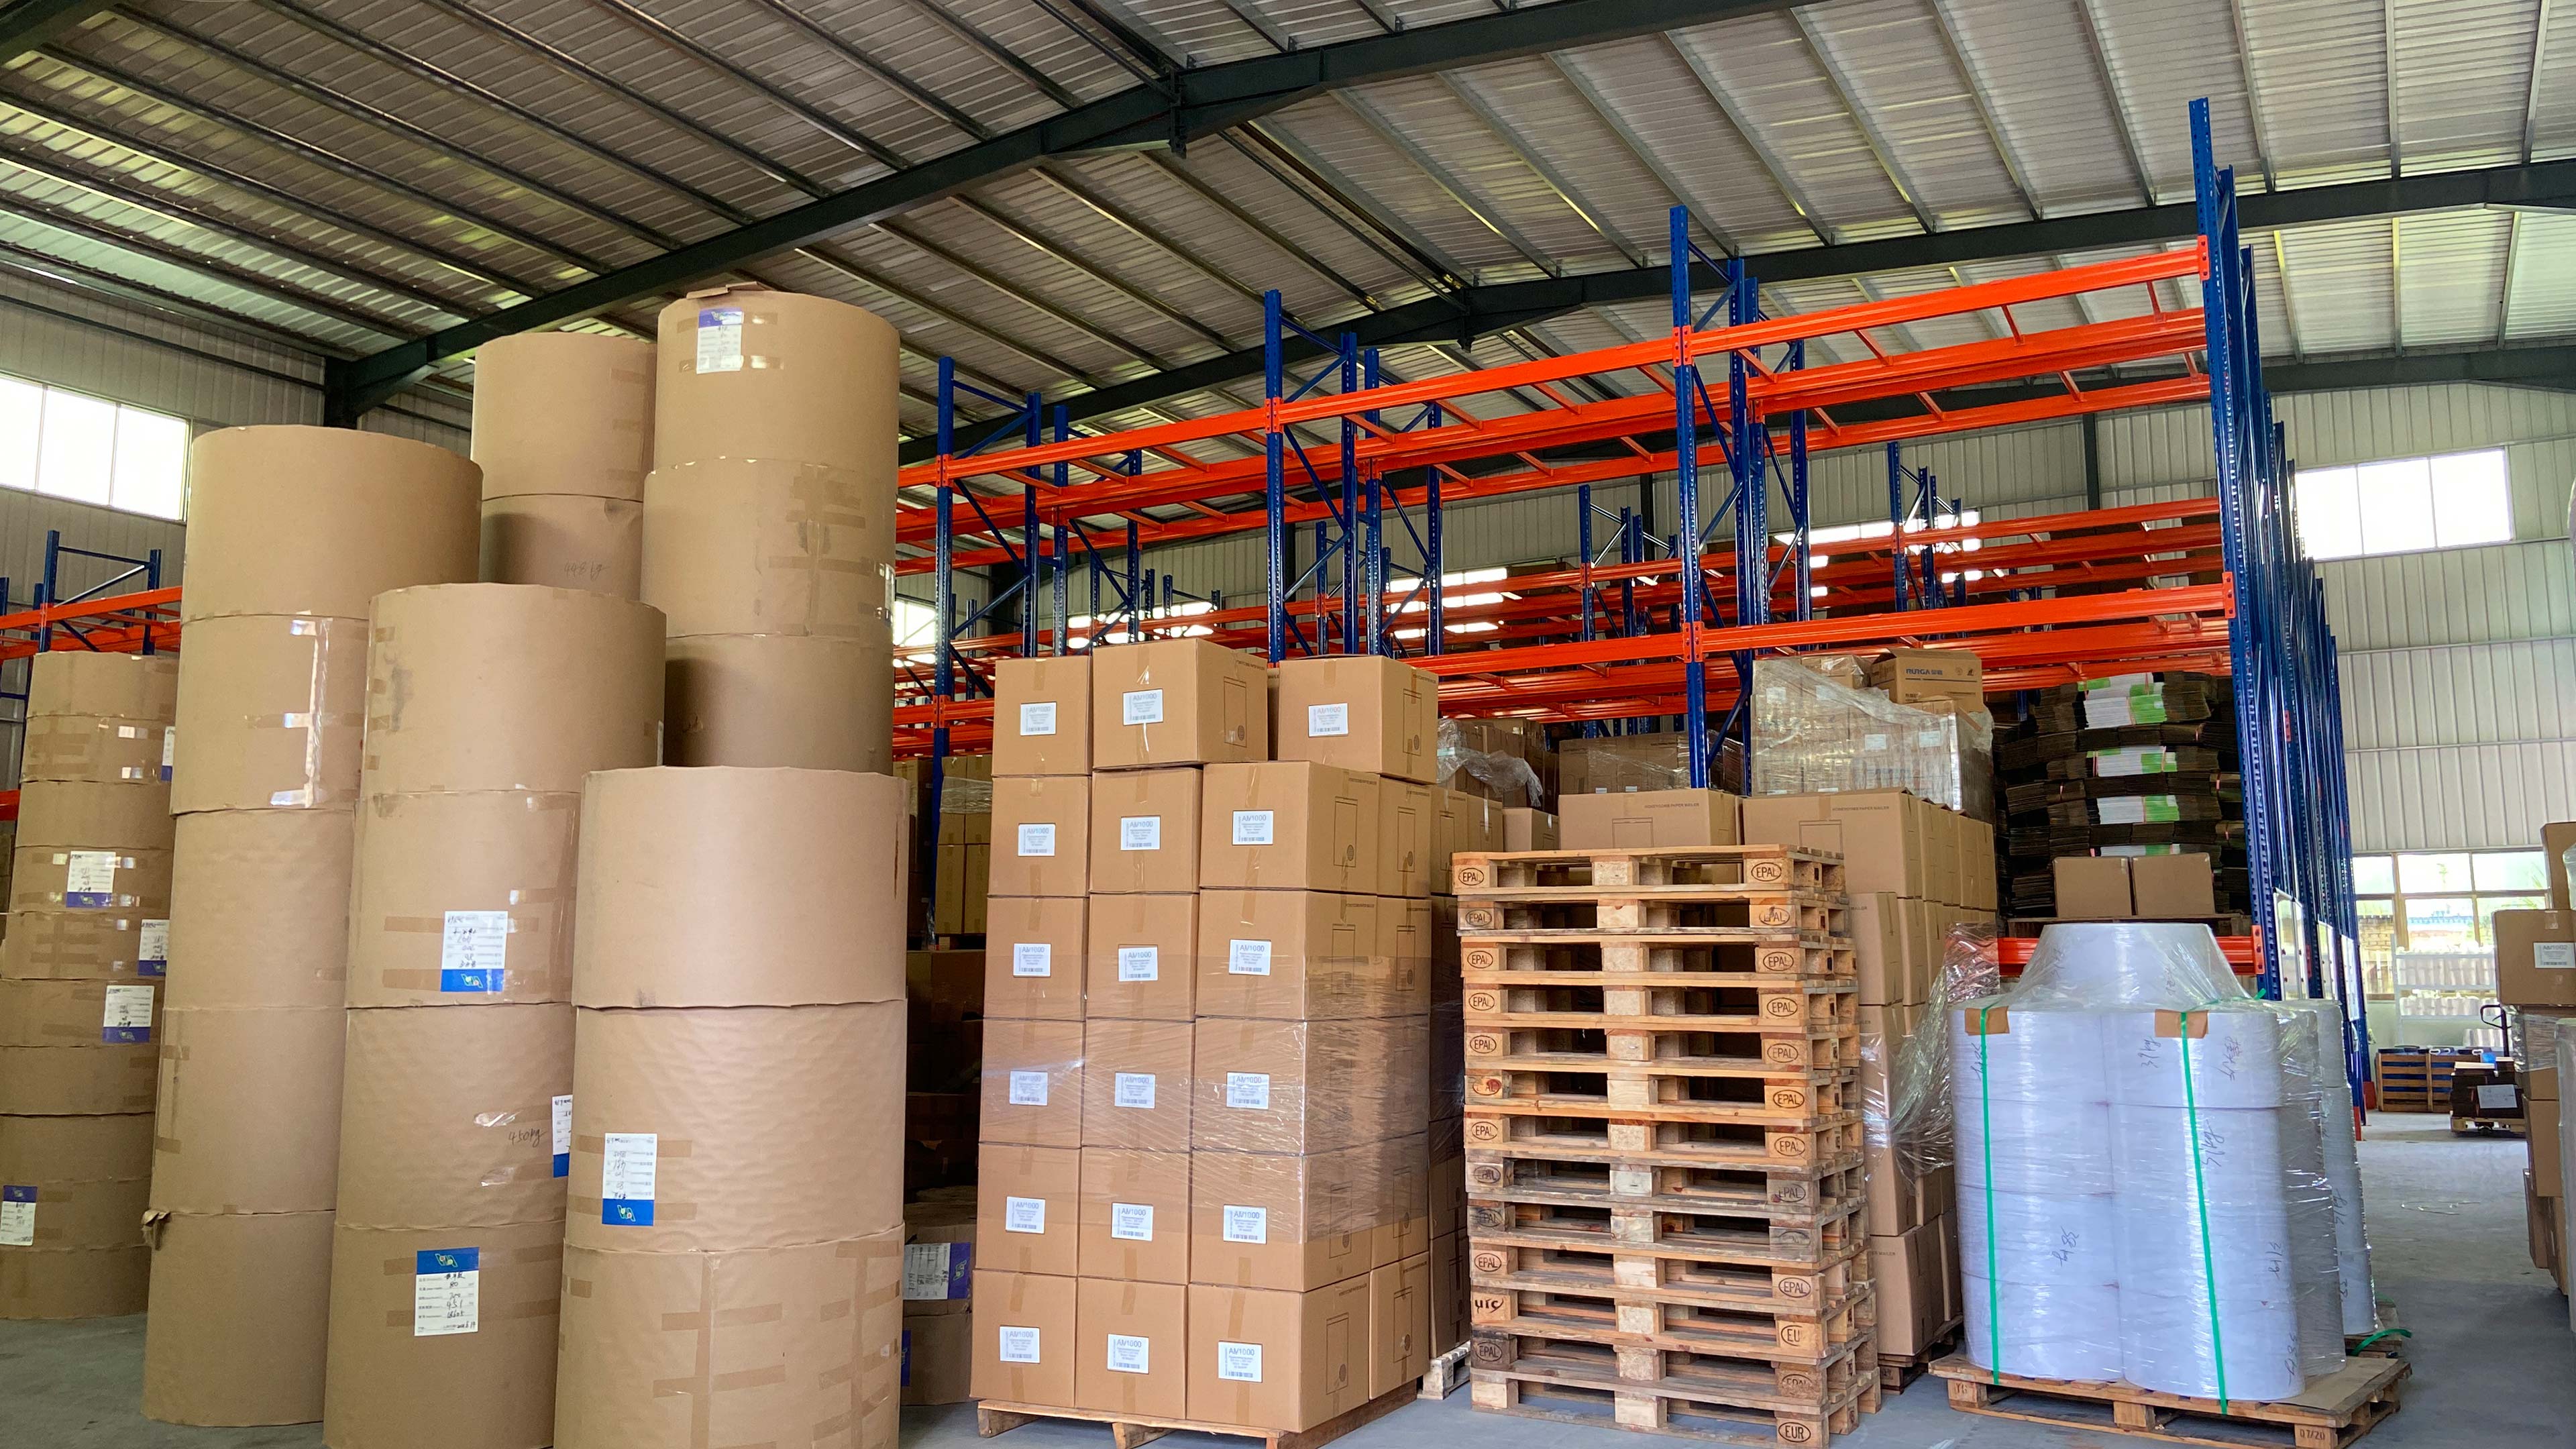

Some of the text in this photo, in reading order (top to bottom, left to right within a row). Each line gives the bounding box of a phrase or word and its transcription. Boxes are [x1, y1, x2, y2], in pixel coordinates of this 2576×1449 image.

[1756, 867, 1778, 878] EPAL
[1469, 914, 1488, 923] EPAL
[1768, 956, 1790, 967] EPAL
[1473, 997, 1492, 1007] EPAL
[1772, 1002, 1794, 1013] EPAL
[1474, 1040, 1493, 1050] EPAL
[1772, 1048, 1794, 1059] EPAL
[1778, 1094, 1801, 1105] EPAL
[1476, 1126, 1495, 1136] EPAL
[1780, 1141, 1802, 1152] EPAL
[2048, 1227, 2079, 1267] 38kg
[1479, 1257, 1498, 1268] EPAL
[1784, 1281, 1807, 1294] EPAL
[1479, 1346, 1499, 1358] EPAL
[1785, 1426, 1805, 1439] EUR
